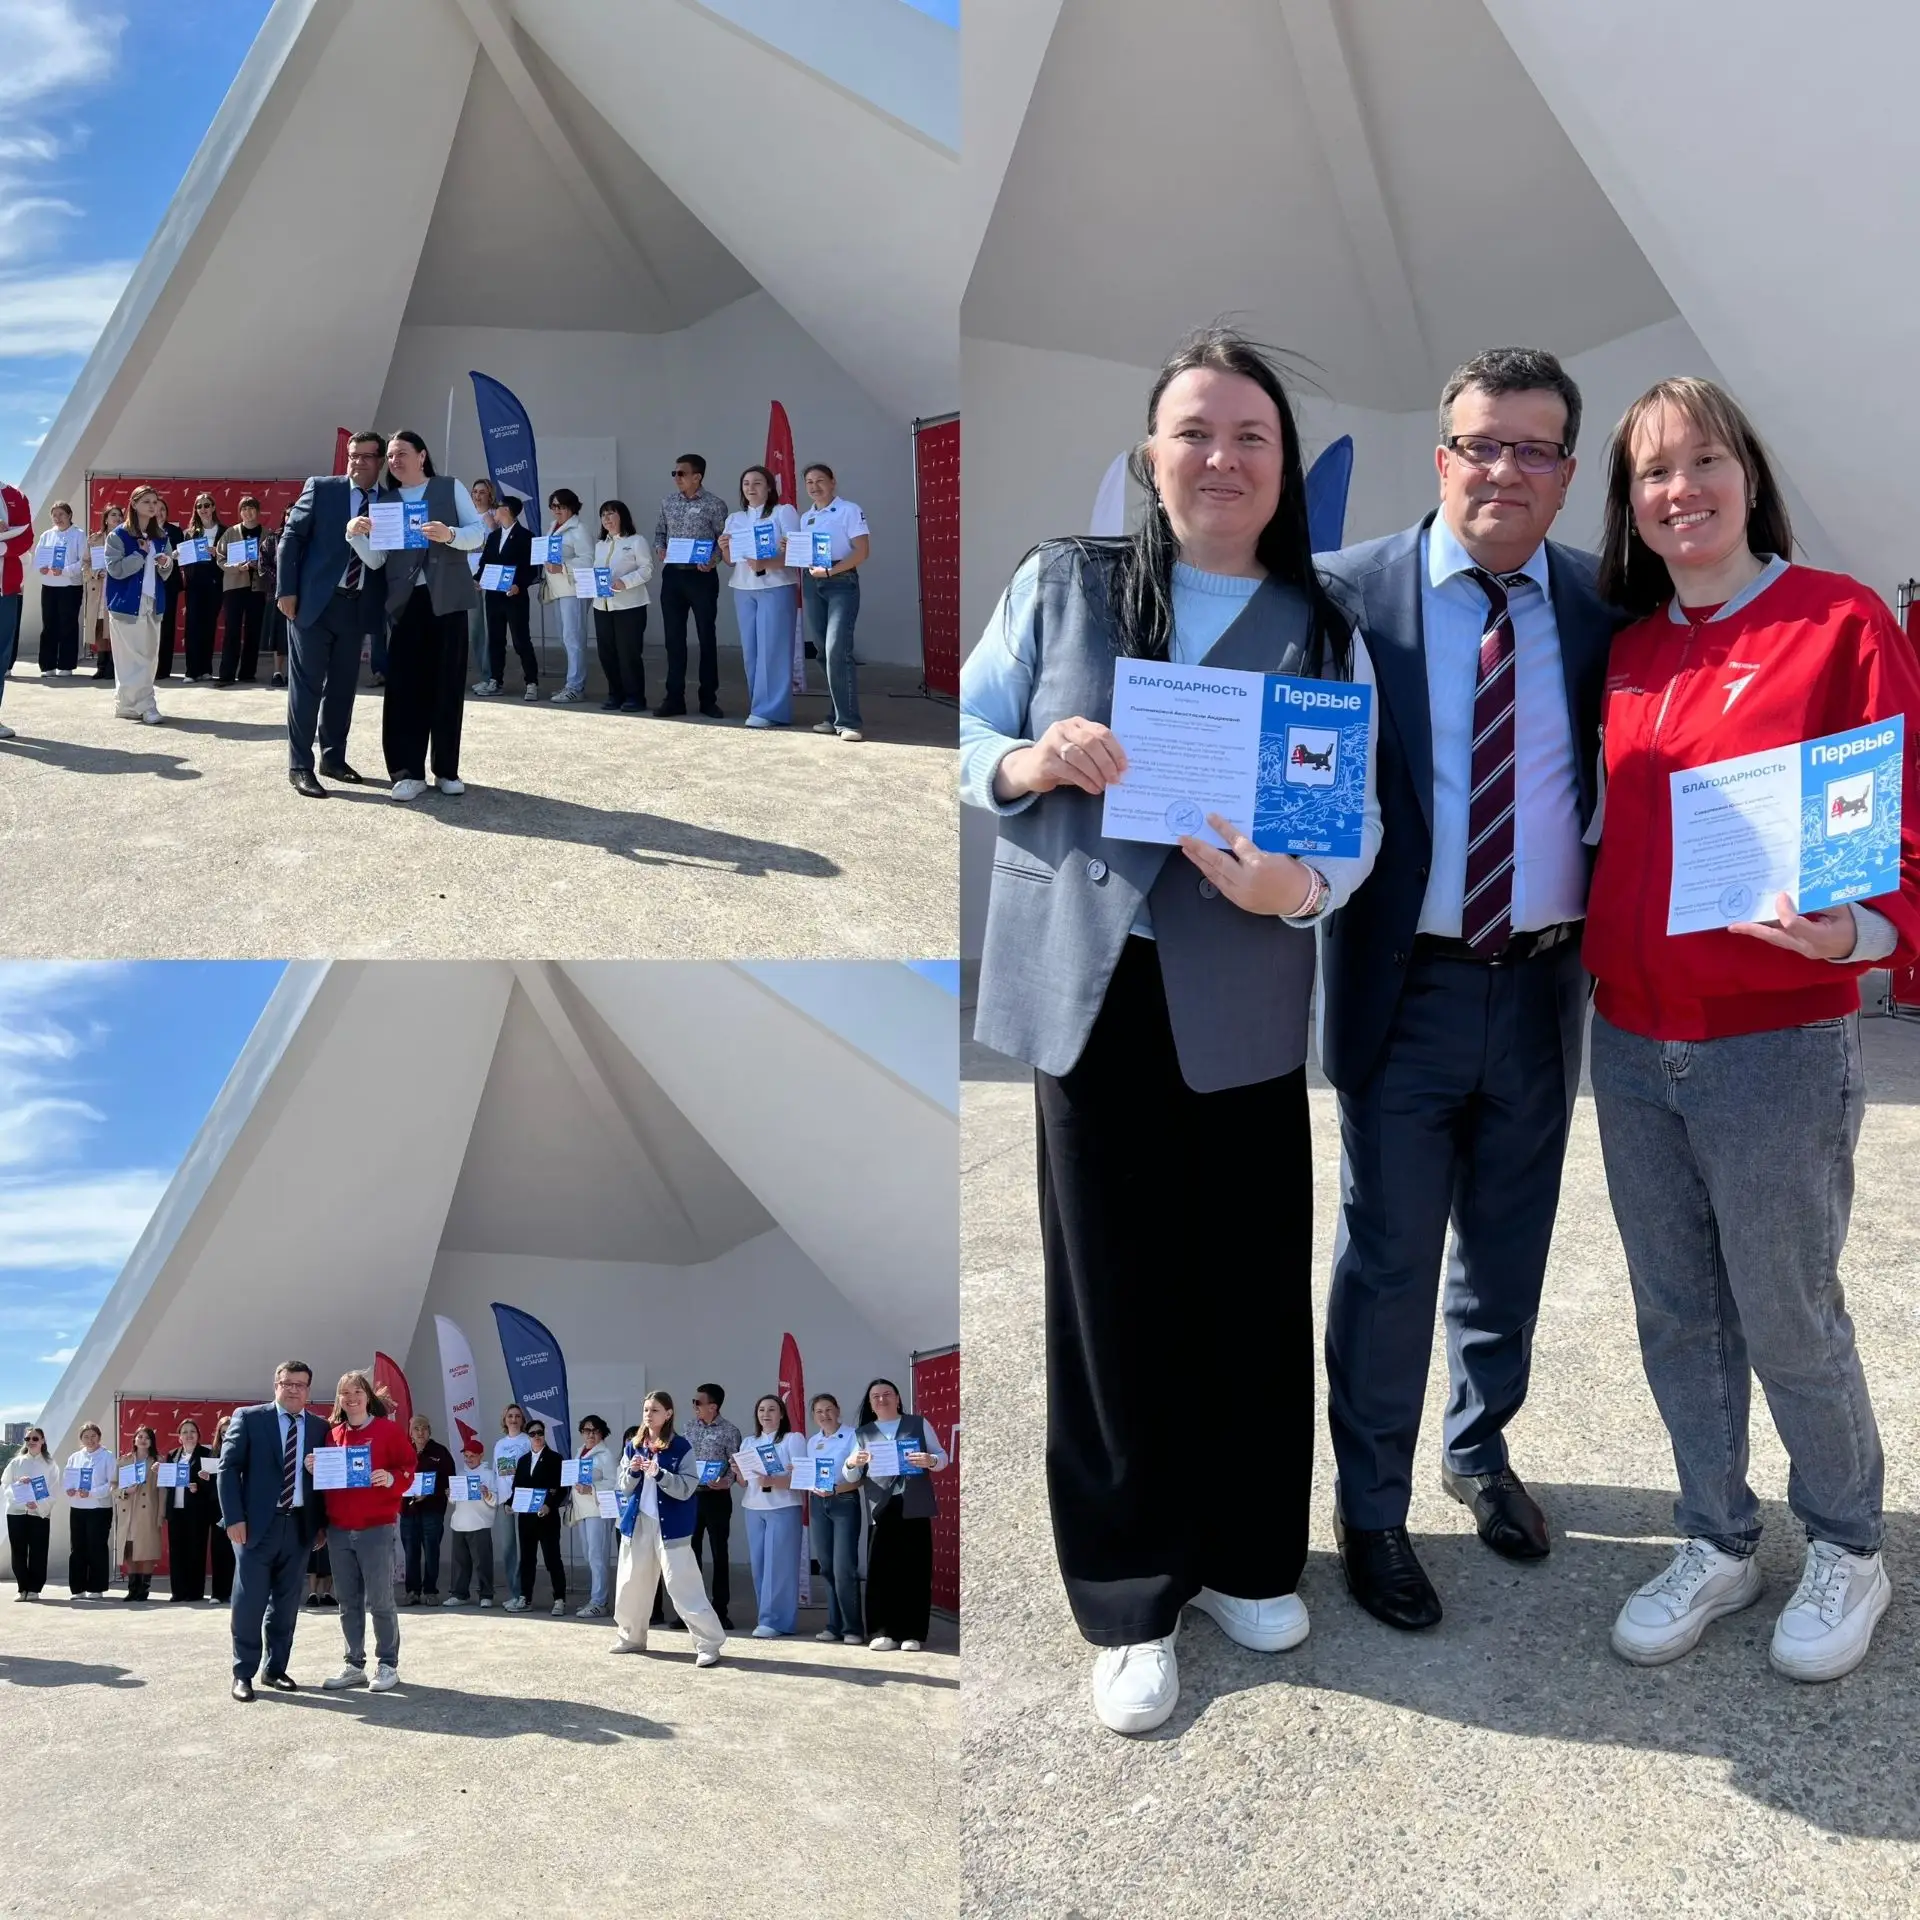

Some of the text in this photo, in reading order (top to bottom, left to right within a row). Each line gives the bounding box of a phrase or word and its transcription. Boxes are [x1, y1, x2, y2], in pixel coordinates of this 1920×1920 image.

[1128, 675, 1248, 697] БЛАГОДАРНОСТЬ
[1274, 684, 1362, 711] Первые
[1811, 730, 1895, 766] Первые
[1682, 763, 1787, 794] БЛАГОДАРНОСТЬ
